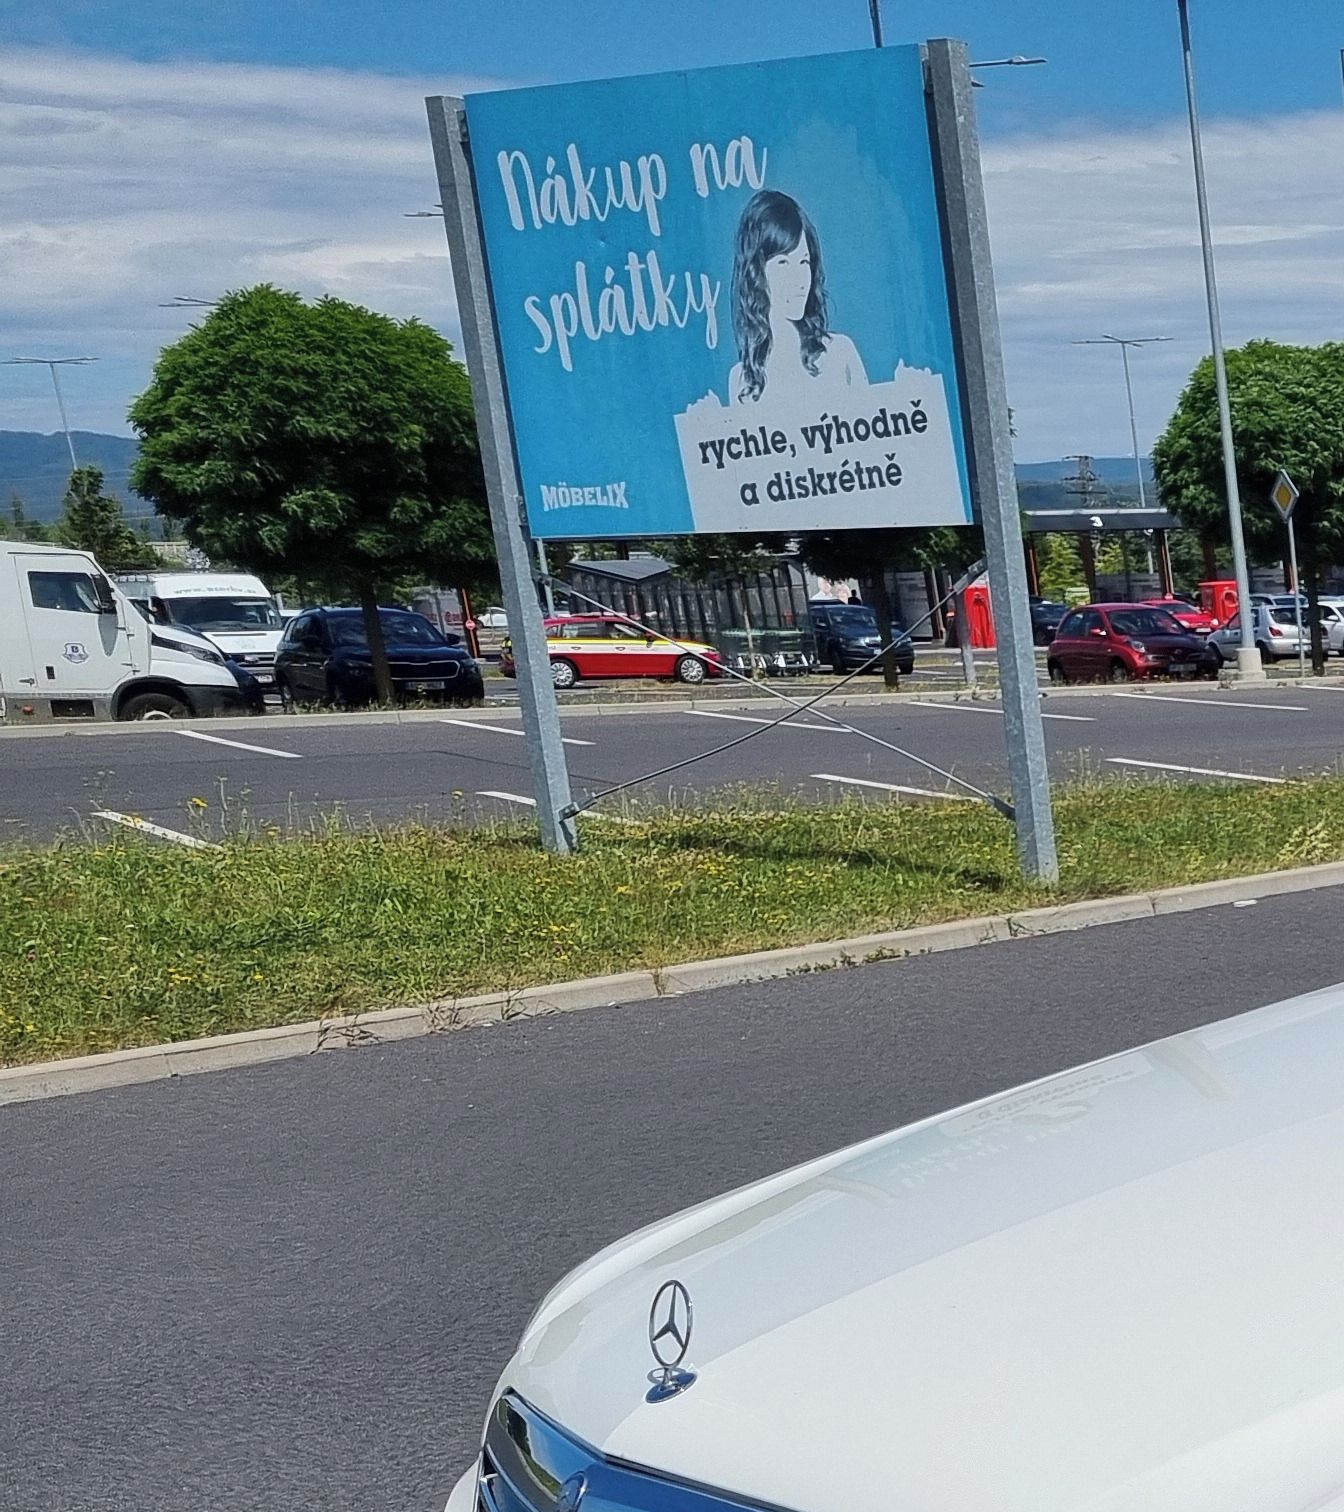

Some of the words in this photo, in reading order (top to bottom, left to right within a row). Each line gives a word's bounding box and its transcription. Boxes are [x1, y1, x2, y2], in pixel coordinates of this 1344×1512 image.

[498, 142, 667, 236] Nákup
[690, 136, 768, 198] na
[524, 249, 721, 371] splátky
[698, 416, 797, 469] rychle,
[801, 399, 929, 456] výhodně
[540, 483, 629, 512] MÖBELIX
[738, 478, 760, 506] a
[766, 453, 904, 504] diskrétně
